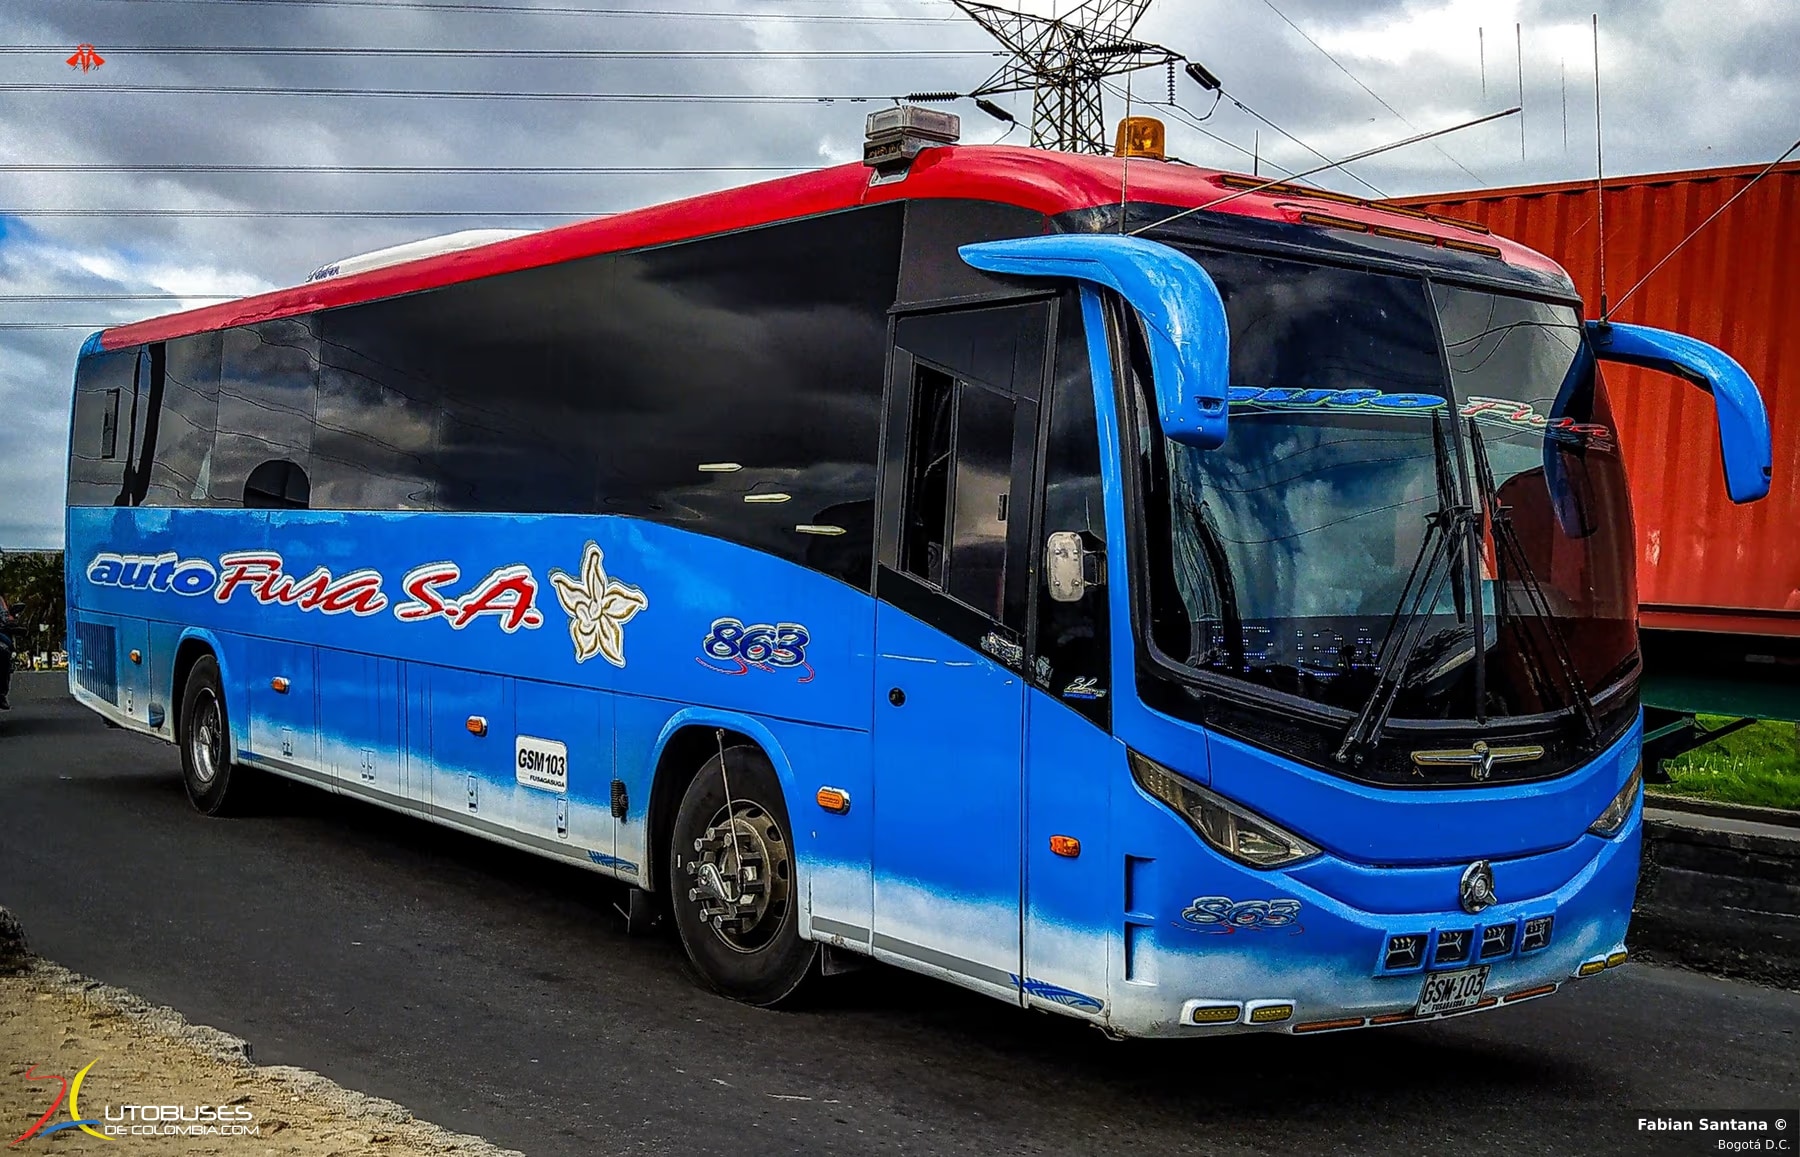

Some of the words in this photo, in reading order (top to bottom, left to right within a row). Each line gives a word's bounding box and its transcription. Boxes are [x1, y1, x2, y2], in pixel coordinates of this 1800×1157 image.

[394, 562, 544, 633] S.A.
[703, 617, 810, 667] 863
[518, 748, 565, 777] GSM103
[1181, 896, 1302, 928] 863
